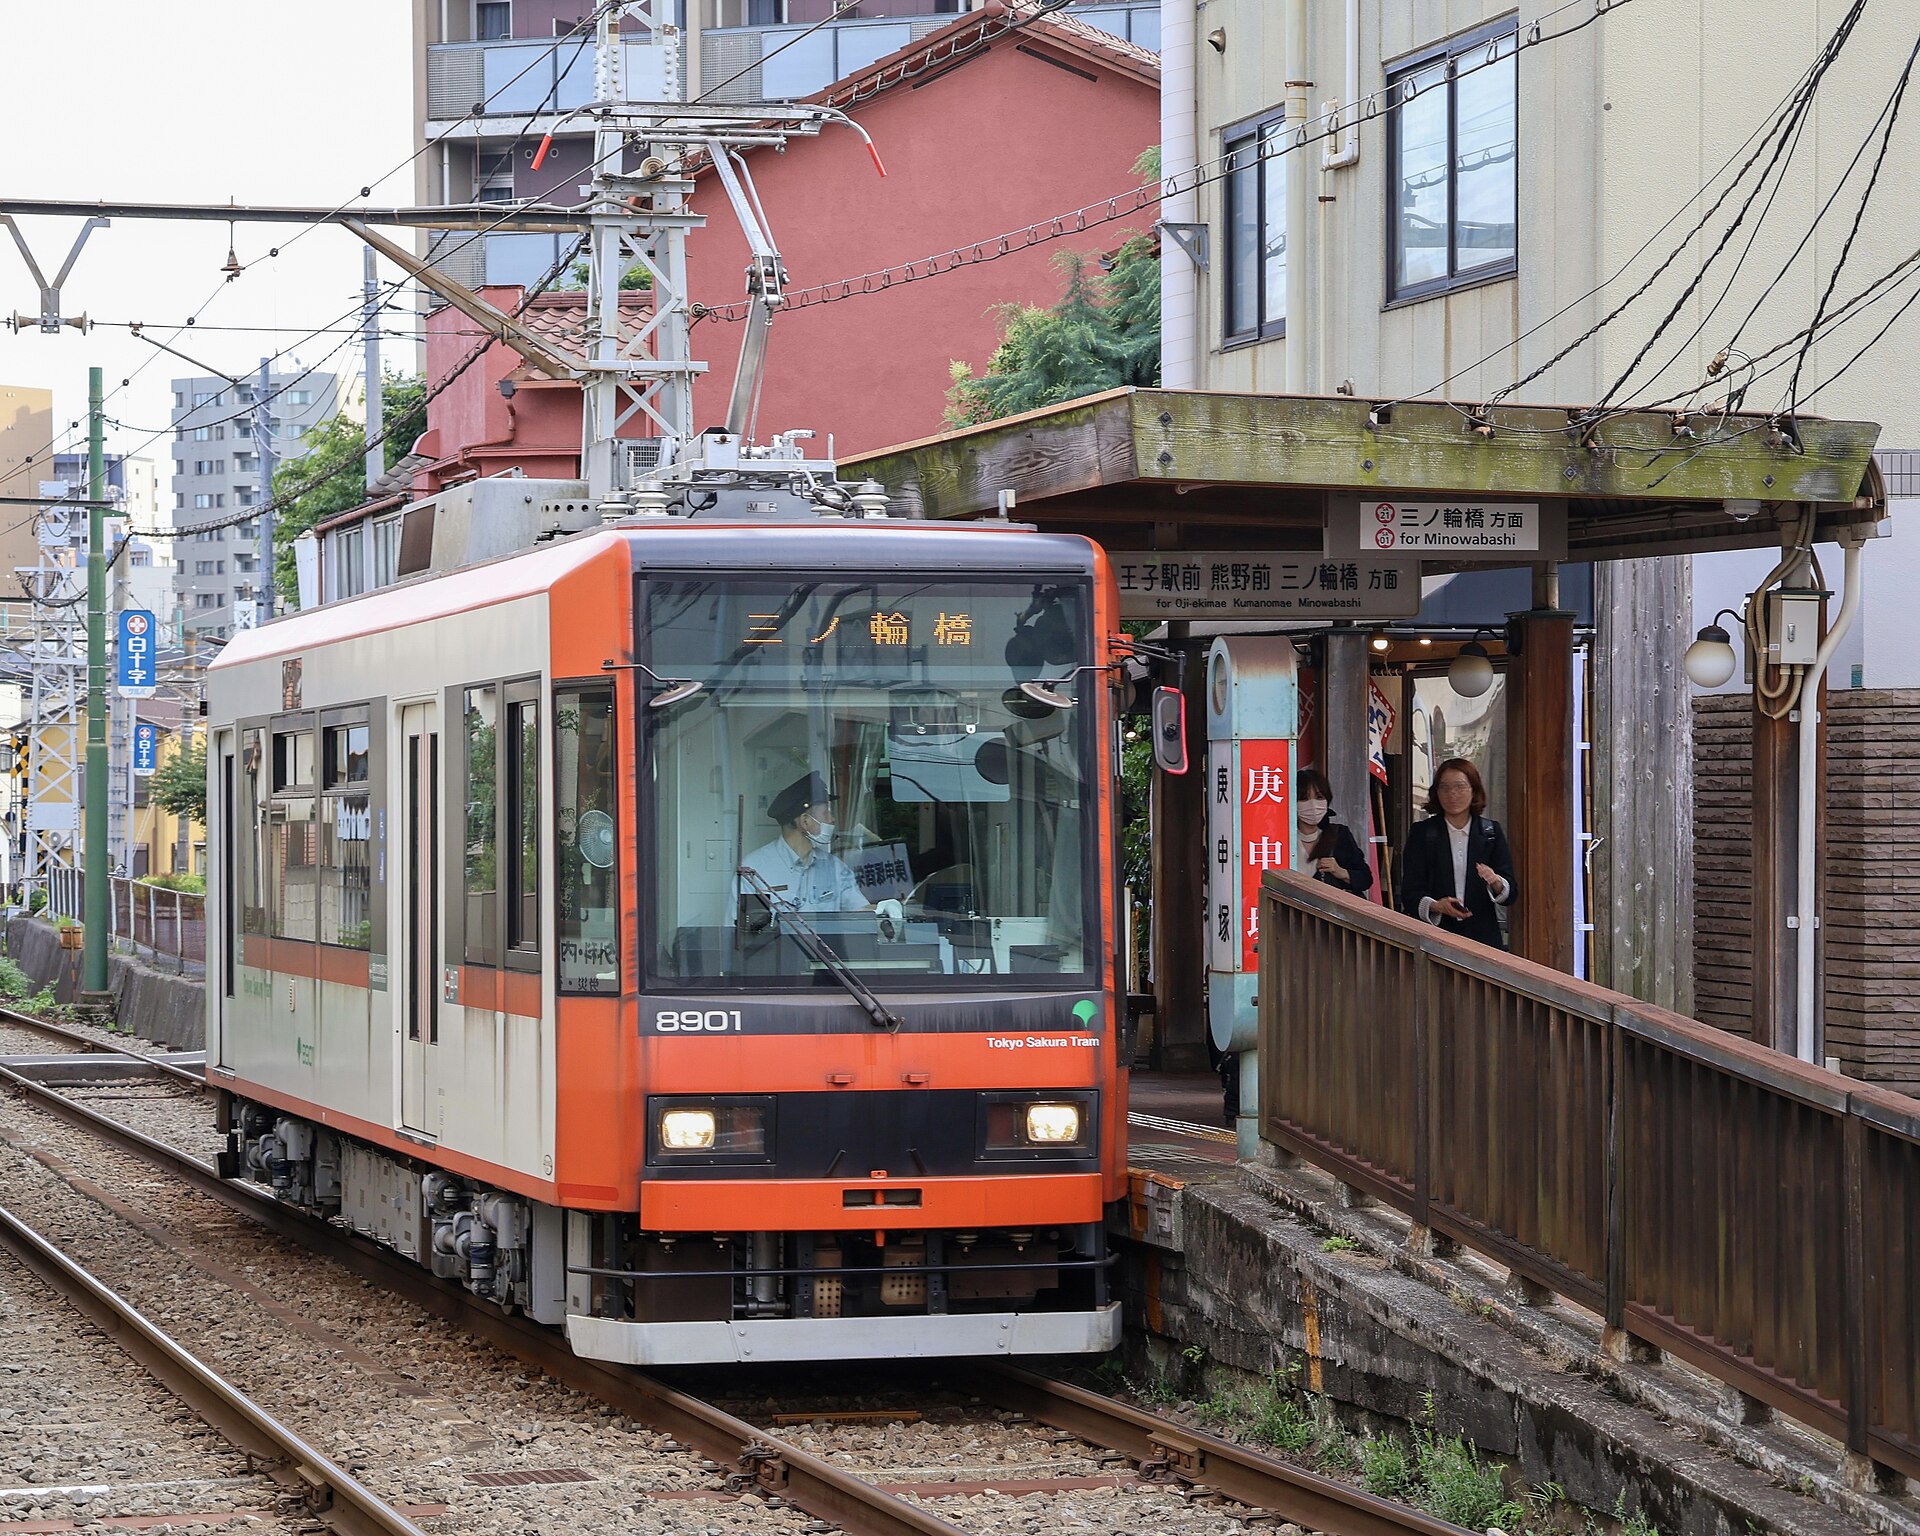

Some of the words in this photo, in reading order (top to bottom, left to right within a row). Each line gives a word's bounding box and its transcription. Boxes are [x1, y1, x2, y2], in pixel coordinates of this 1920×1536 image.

[1380, 511, 1390, 519] 21
[1400, 508, 1484, 528] 三ノ輪橋
[1490, 512, 1523, 528] 方面
[1380, 536, 1390, 544] 01
[1400, 532, 1420, 545] for
[1424, 532, 1516, 545] Minowabashi
[1120, 563, 1201, 591] 王子駅前
[1211, 563, 1271, 591] 熊野前
[1281, 563, 1358, 591] 三ノ輪橋
[1368, 569, 1398, 590] 方面
[1156, 598, 1172, 608] for
[1175, 598, 1227, 609] Oji-ekimae
[1233, 598, 1292, 608] Kumanomae
[1298, 597, 1361, 608] Minowabashi
[743, 612, 972, 645] 三ノ輪橋
[128, 636, 147, 685] 白十字
[138, 739, 151, 768] 白十字
[1217, 765, 1230, 942] 庚申塚
[656, 1011, 742, 1032] 8901
[986, 1037, 1024, 1050] Tokyo
[1026, 1036, 1068, 1048] Sakura
[1069, 1036, 1100, 1047] Tram
